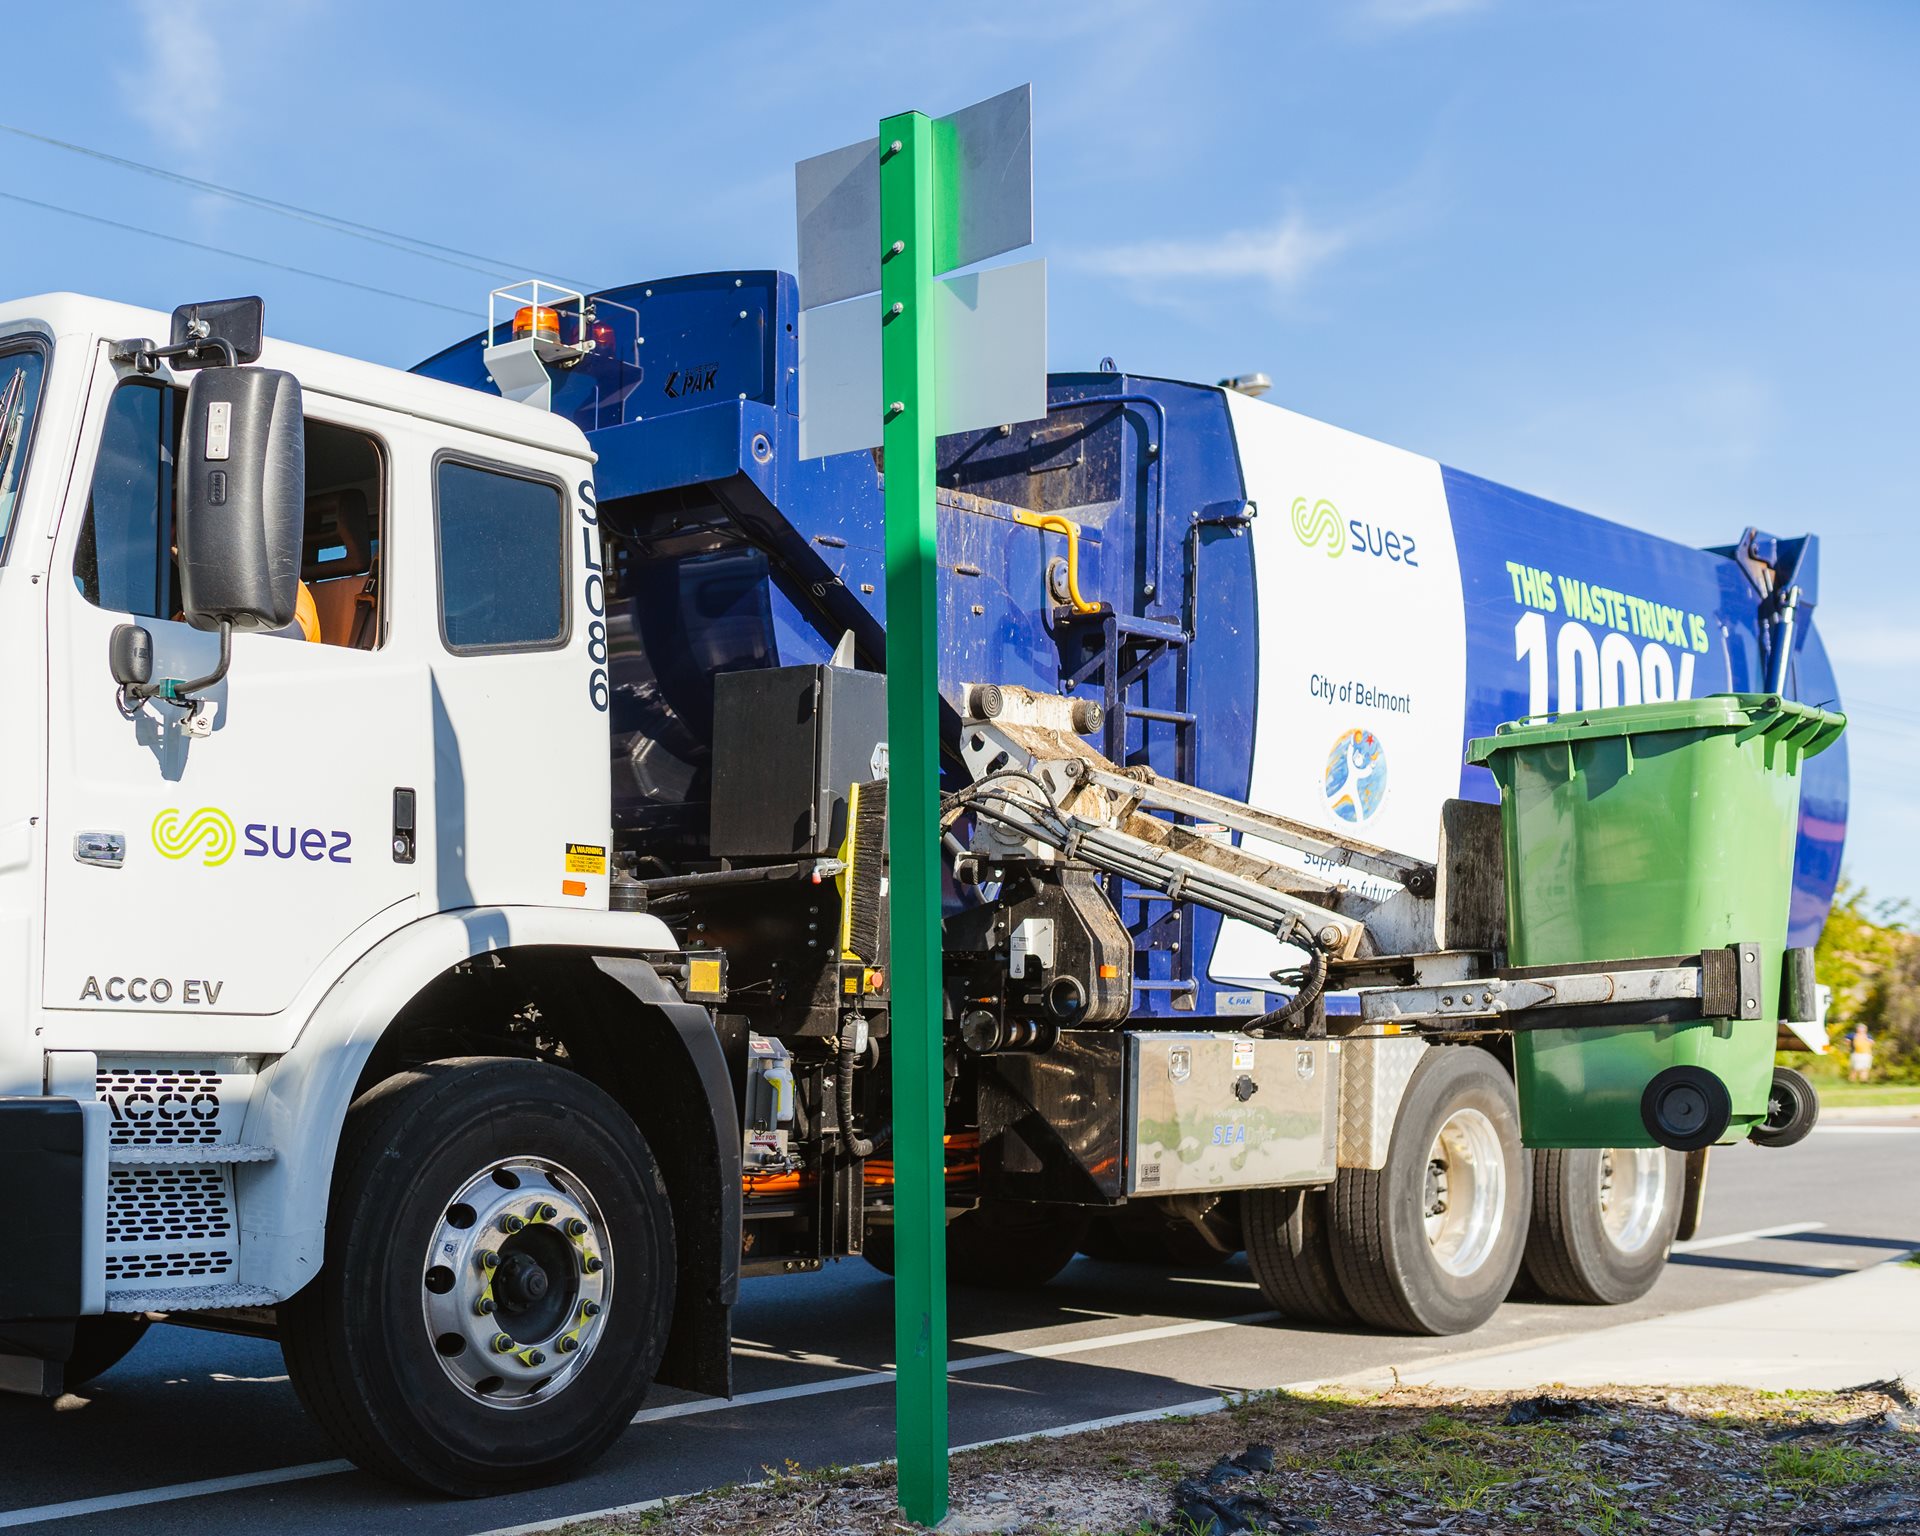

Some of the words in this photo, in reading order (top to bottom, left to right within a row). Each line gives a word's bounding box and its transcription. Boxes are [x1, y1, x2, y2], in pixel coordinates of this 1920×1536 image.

[682, 370, 717, 396] PAK
[1506, 560, 1557, 613] THIS
[1558, 575, 1629, 633] WASTE
[1626, 594, 1689, 649] TRUCK
[1688, 613, 1709, 654] IS
[1310, 674, 1336, 705] City
[1339, 681, 1352, 702] of
[1355, 682, 1411, 714] Belmont
[576, 845, 603, 855] WARNING
[79, 975, 173, 1003] ACCO
[183, 979, 224, 1005] EV
